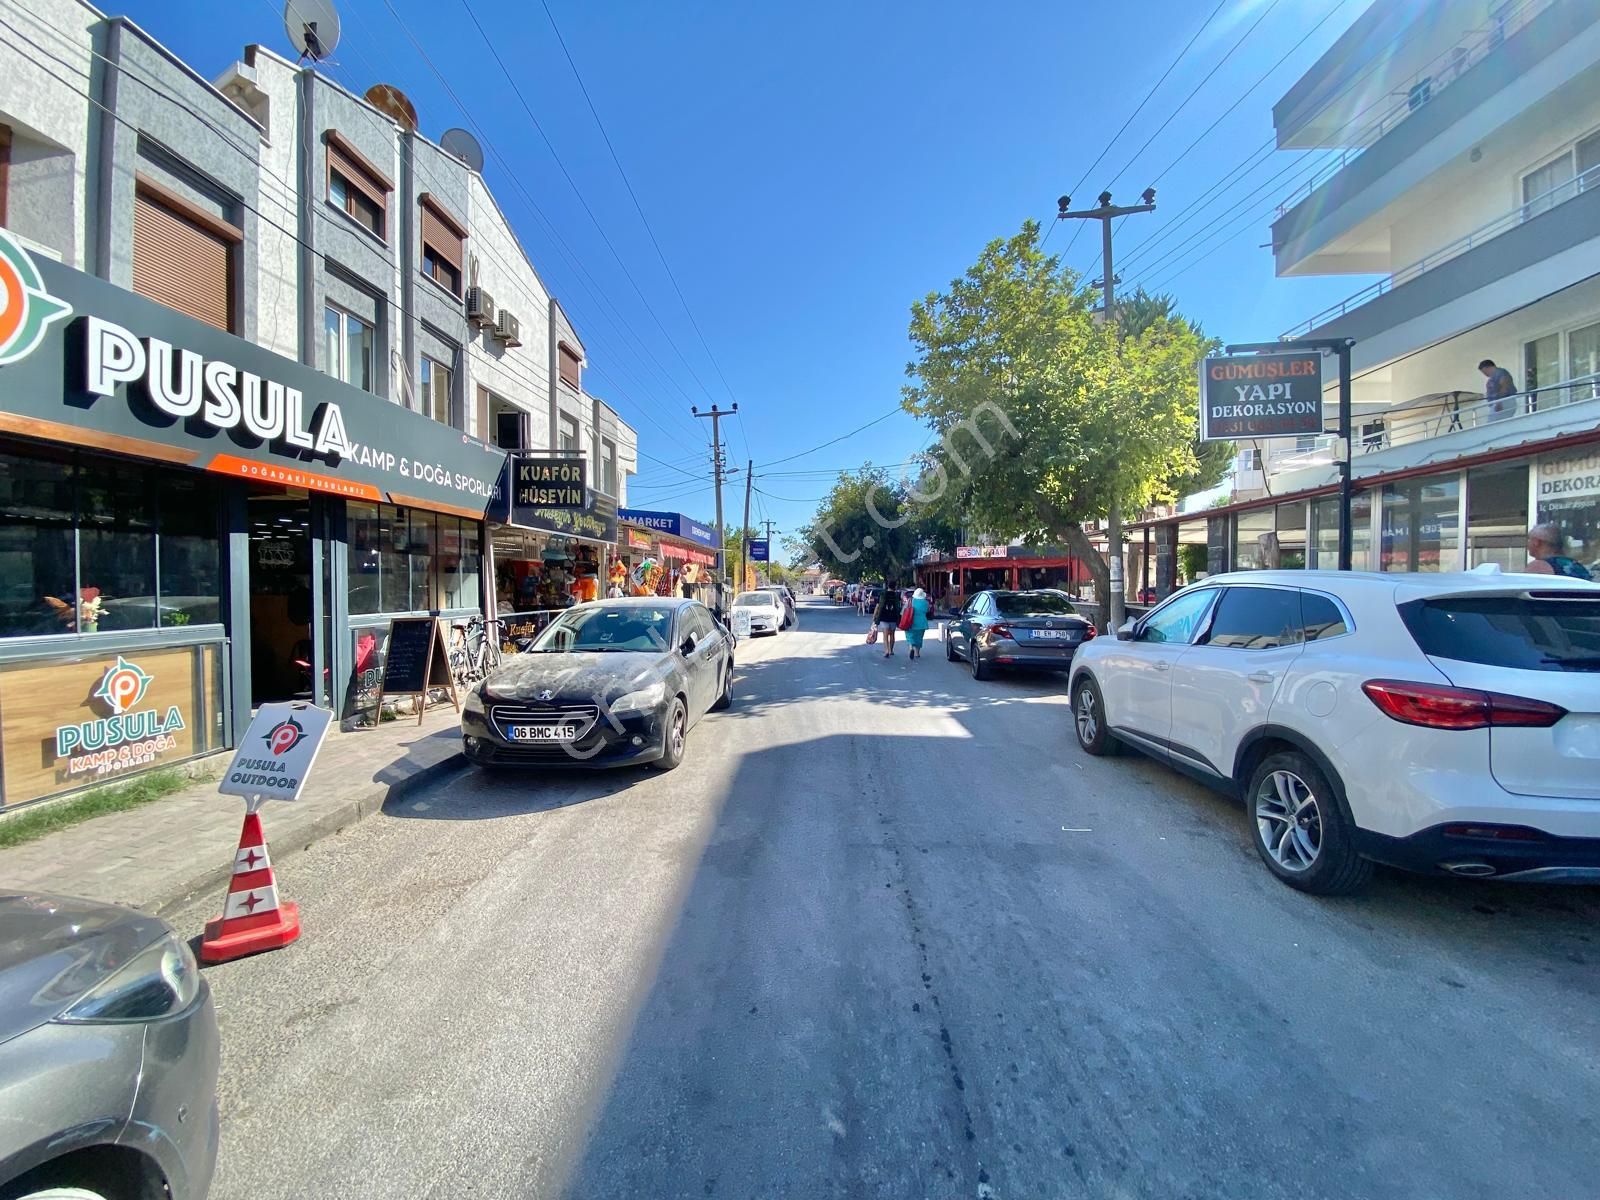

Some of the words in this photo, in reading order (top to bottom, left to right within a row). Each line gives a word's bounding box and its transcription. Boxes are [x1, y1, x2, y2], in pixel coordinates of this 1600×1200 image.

[1211, 360, 1315, 380] GÜMÜŞLER
[88, 315, 349, 459] PUSULA
[1235, 382, 1292, 401] YAPI
[1212, 401, 1316, 418] DEKORASYON
[241, 464, 306, 484] DOĞADAKİ
[349, 442, 395, 472] KAMP
[399, 457, 410, 477] &
[413, 463, 452, 488] DOĞA
[520, 464, 581, 482] KUAFÖR
[519, 485, 581, 504] HÜSEYİN
[629, 516, 674, 529] MARKET
[57, 705, 186, 757] PUSULA
[514, 727, 527, 738] 06
[529, 727, 551, 738] BMC
[554, 727, 574, 738] 415
[70, 749, 117, 774] KAMP
[118, 746, 131, 760] &
[132, 735, 176, 758] DOĞA
[237, 758, 286, 772] PUSULA
[230, 772, 298, 789] OUTDOOR
